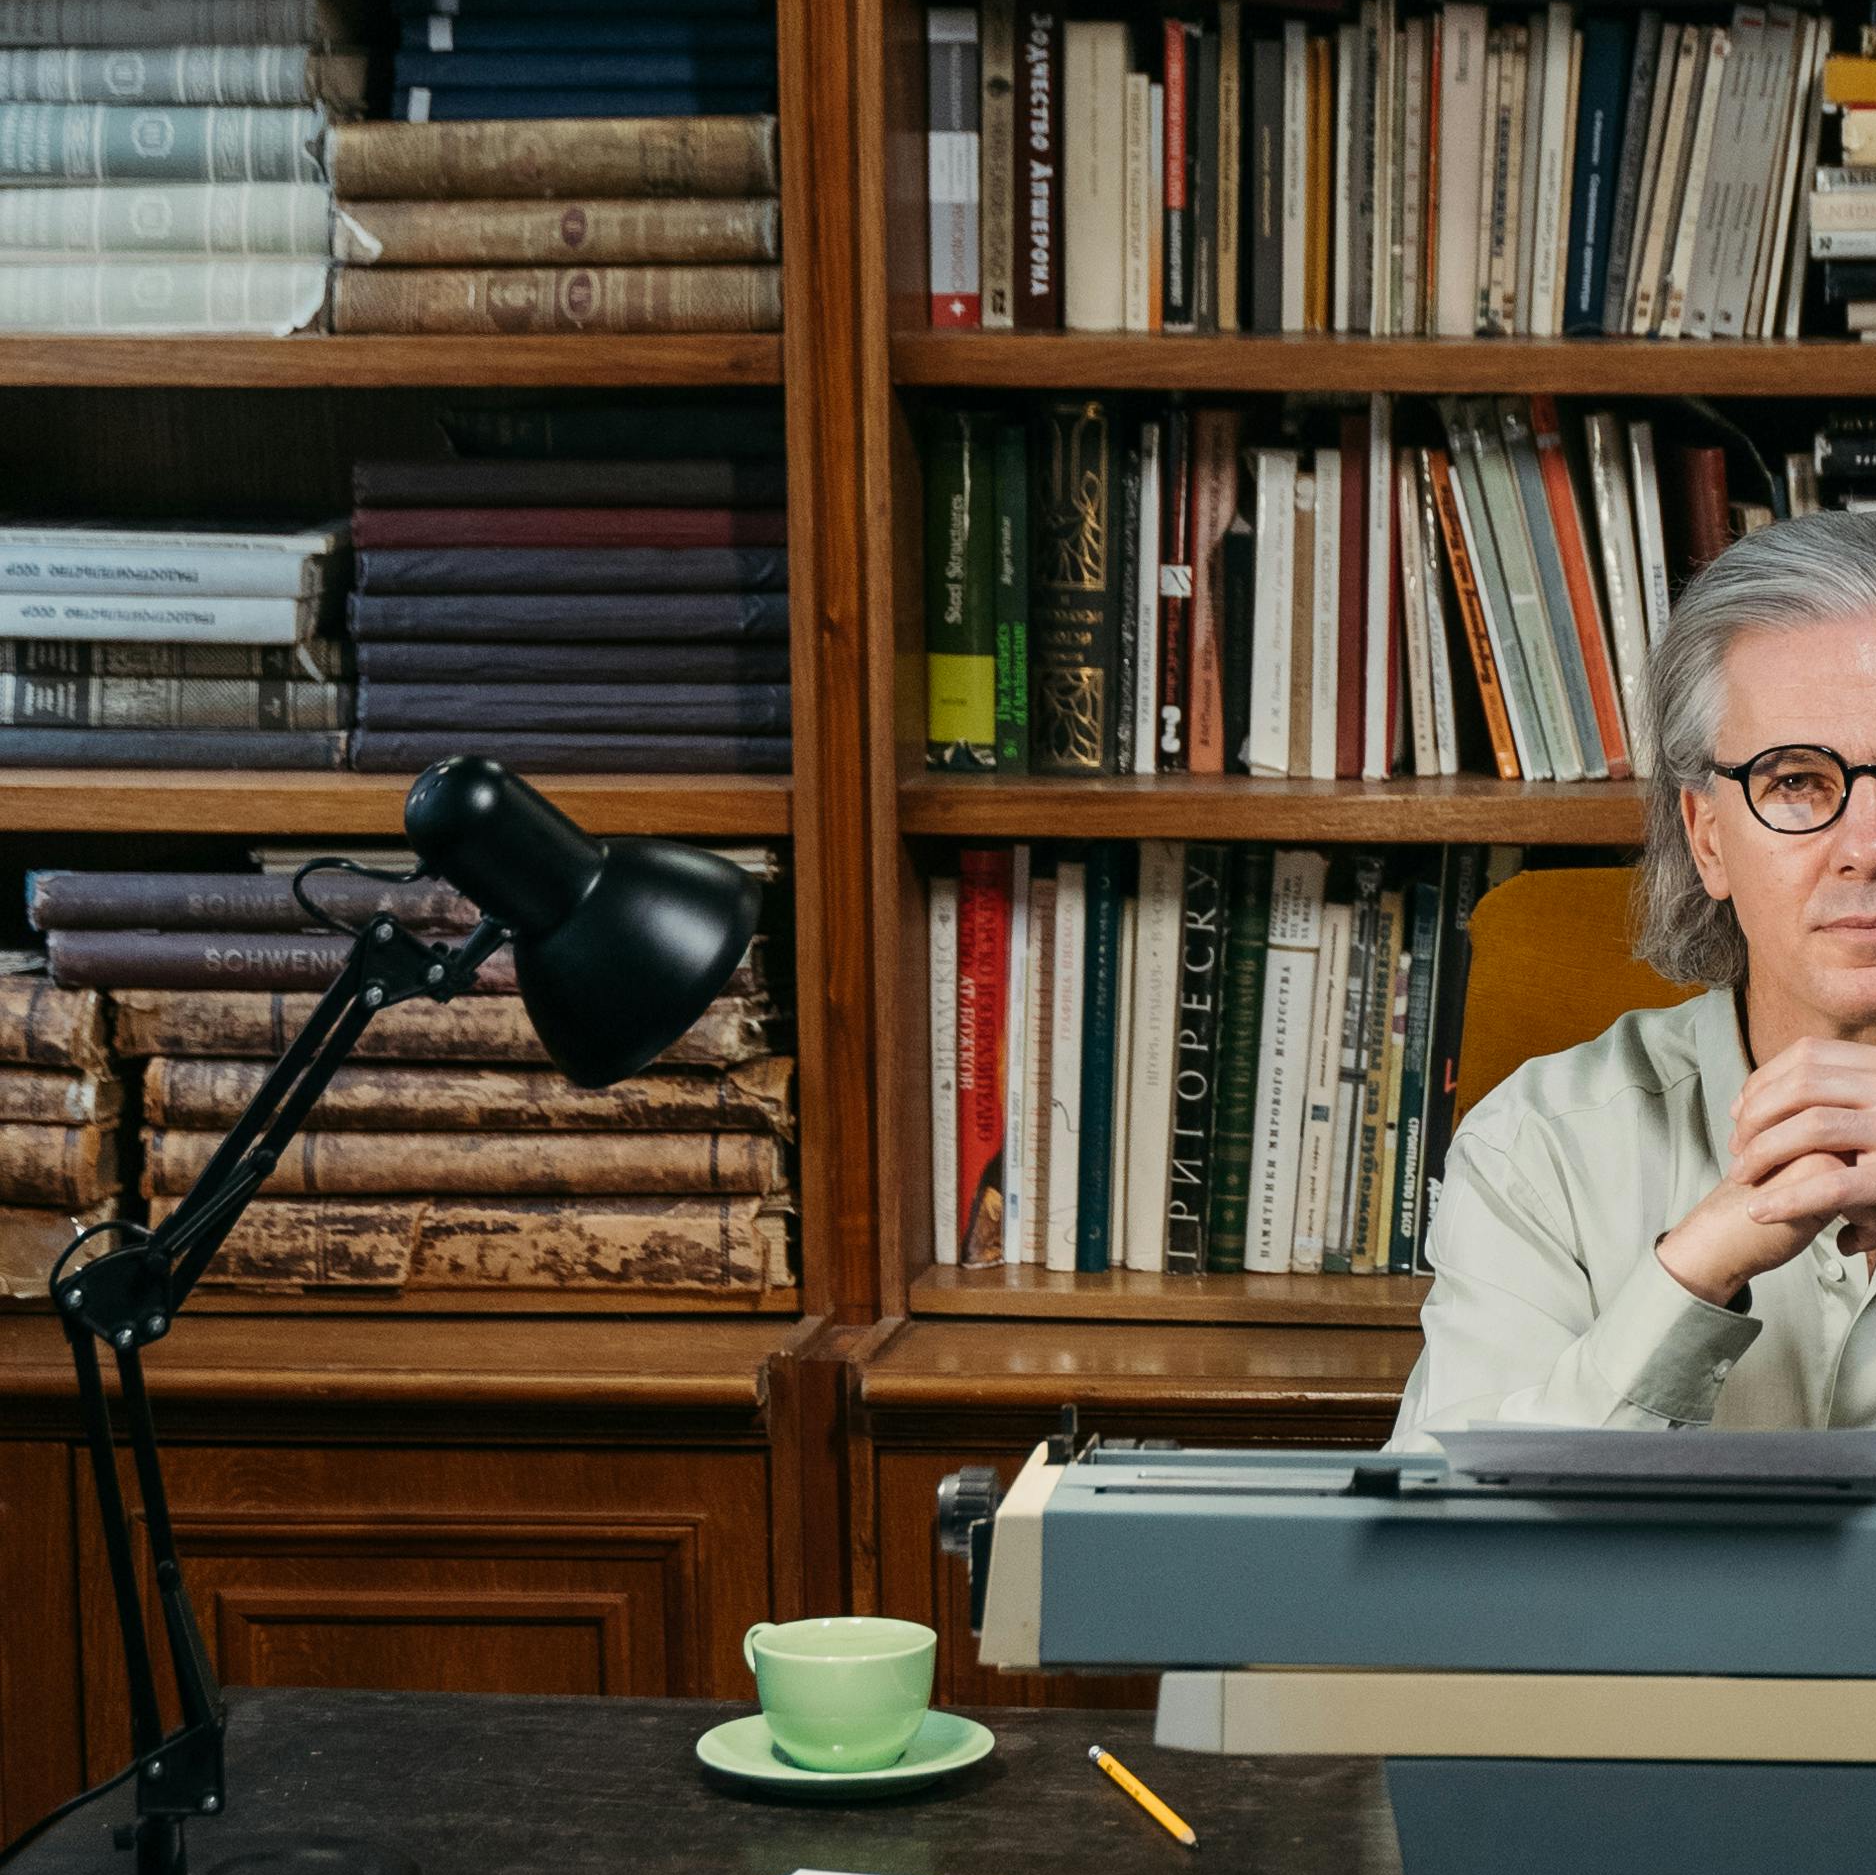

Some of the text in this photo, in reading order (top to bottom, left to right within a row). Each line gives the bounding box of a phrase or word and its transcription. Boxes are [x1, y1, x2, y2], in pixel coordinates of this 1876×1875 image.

[1166, 864, 1221, 1261] ГРИГОРЕСКУ
[1258, 964, 1293, 1259] ПАМЯТНИКИ МИРОВОГО ИСКУССТВА
[1404, 1116, 1421, 1200] СТРОИТЕЛЬСТВО
